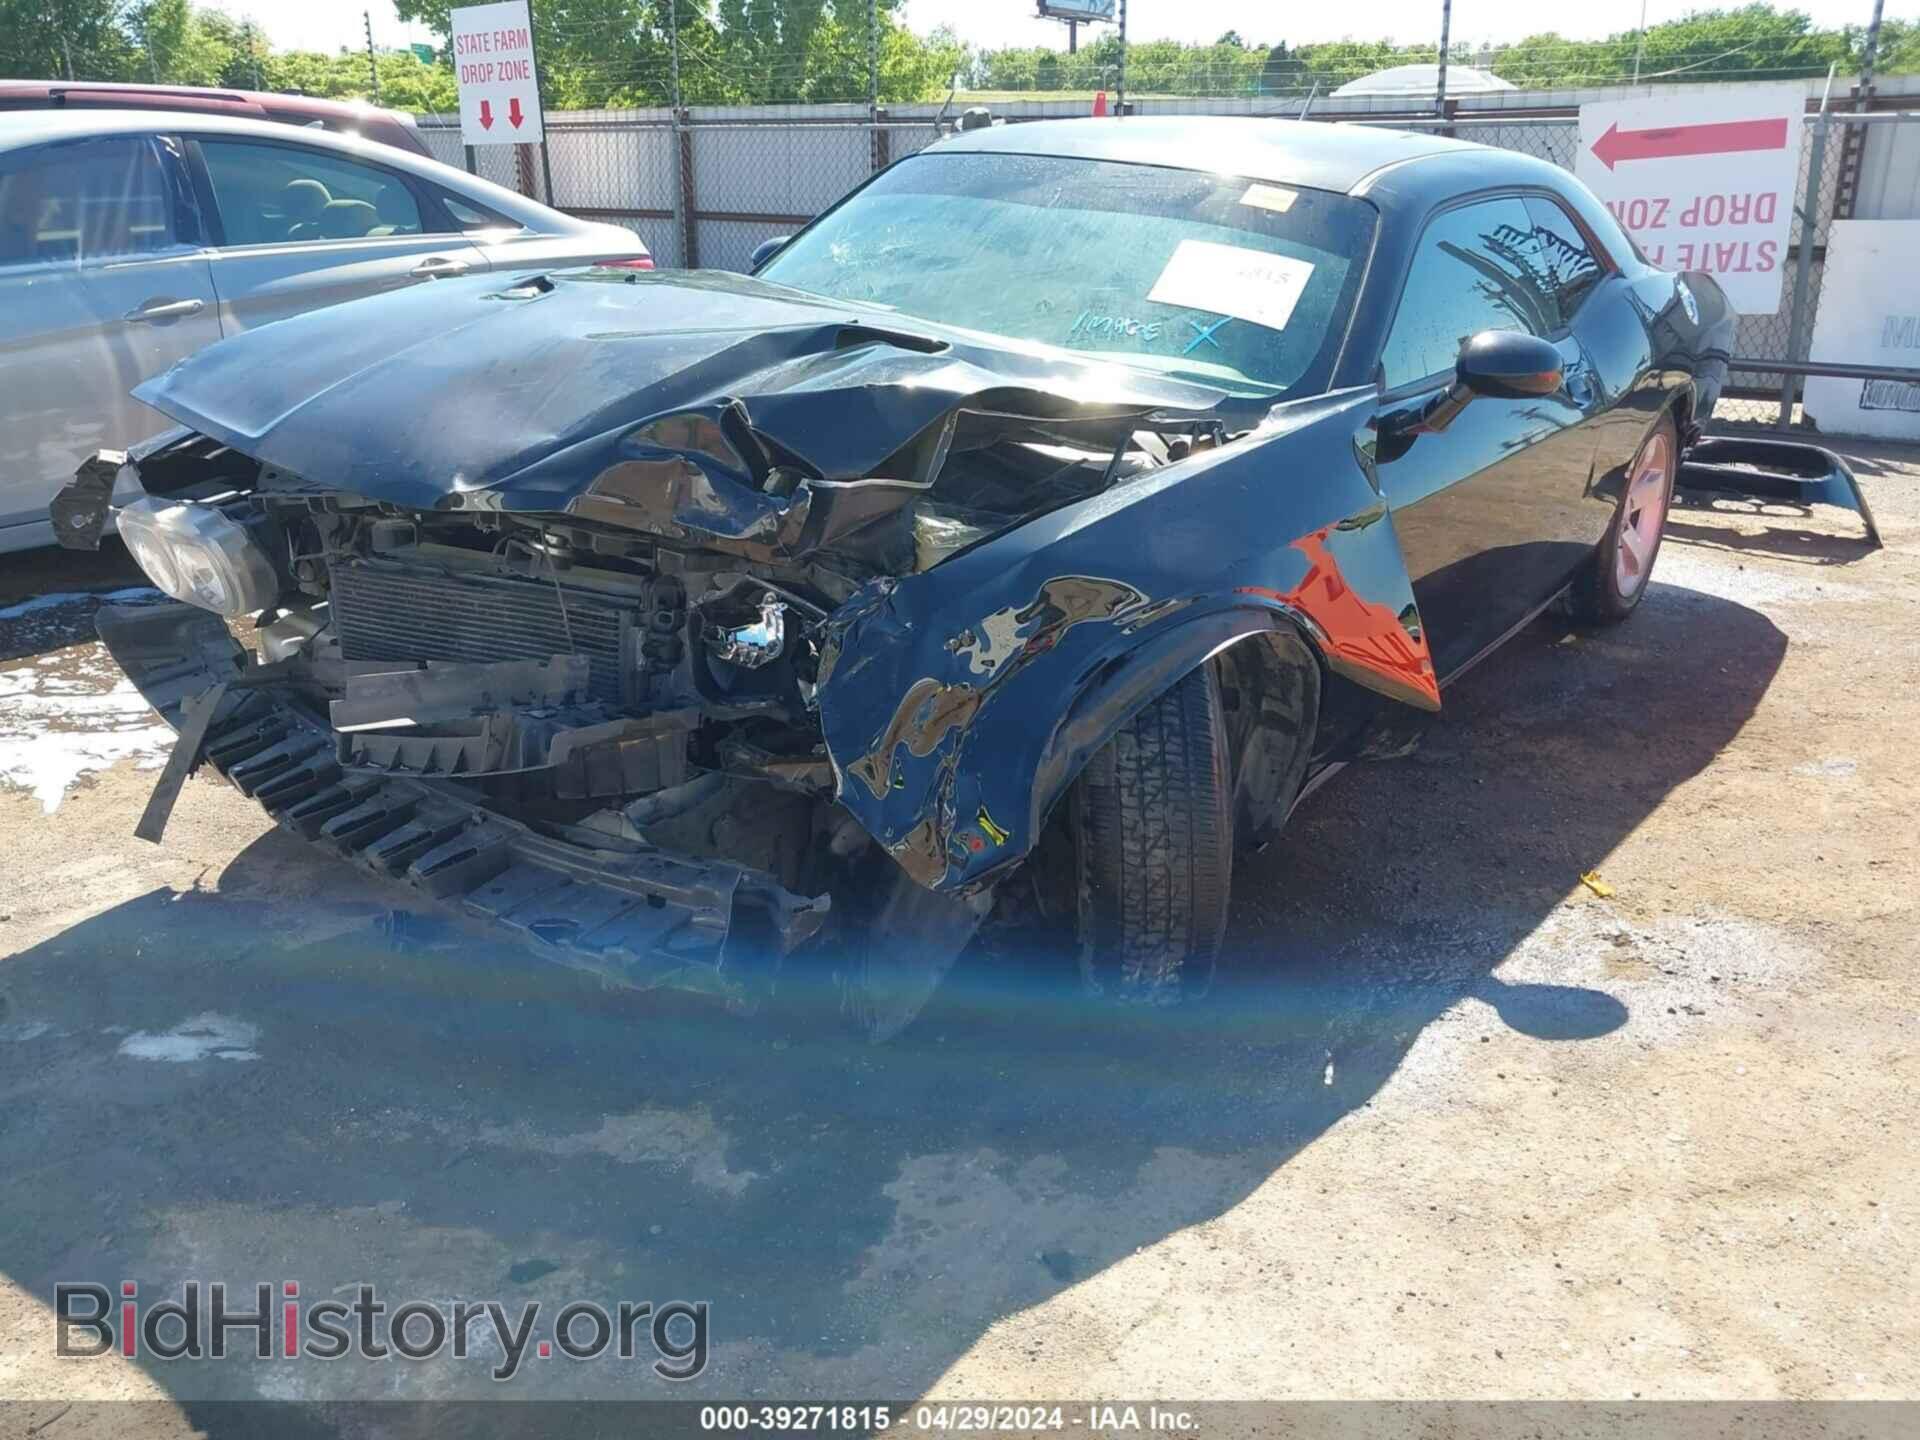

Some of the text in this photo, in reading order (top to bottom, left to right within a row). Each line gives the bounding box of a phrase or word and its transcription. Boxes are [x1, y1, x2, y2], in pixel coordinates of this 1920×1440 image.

[456, 29, 529, 55] STATE FARM
[461, 60, 531, 84] DROP ZONE
[1605, 191, 1777, 230] DROP ZON
[1676, 240, 1777, 273] STATE
